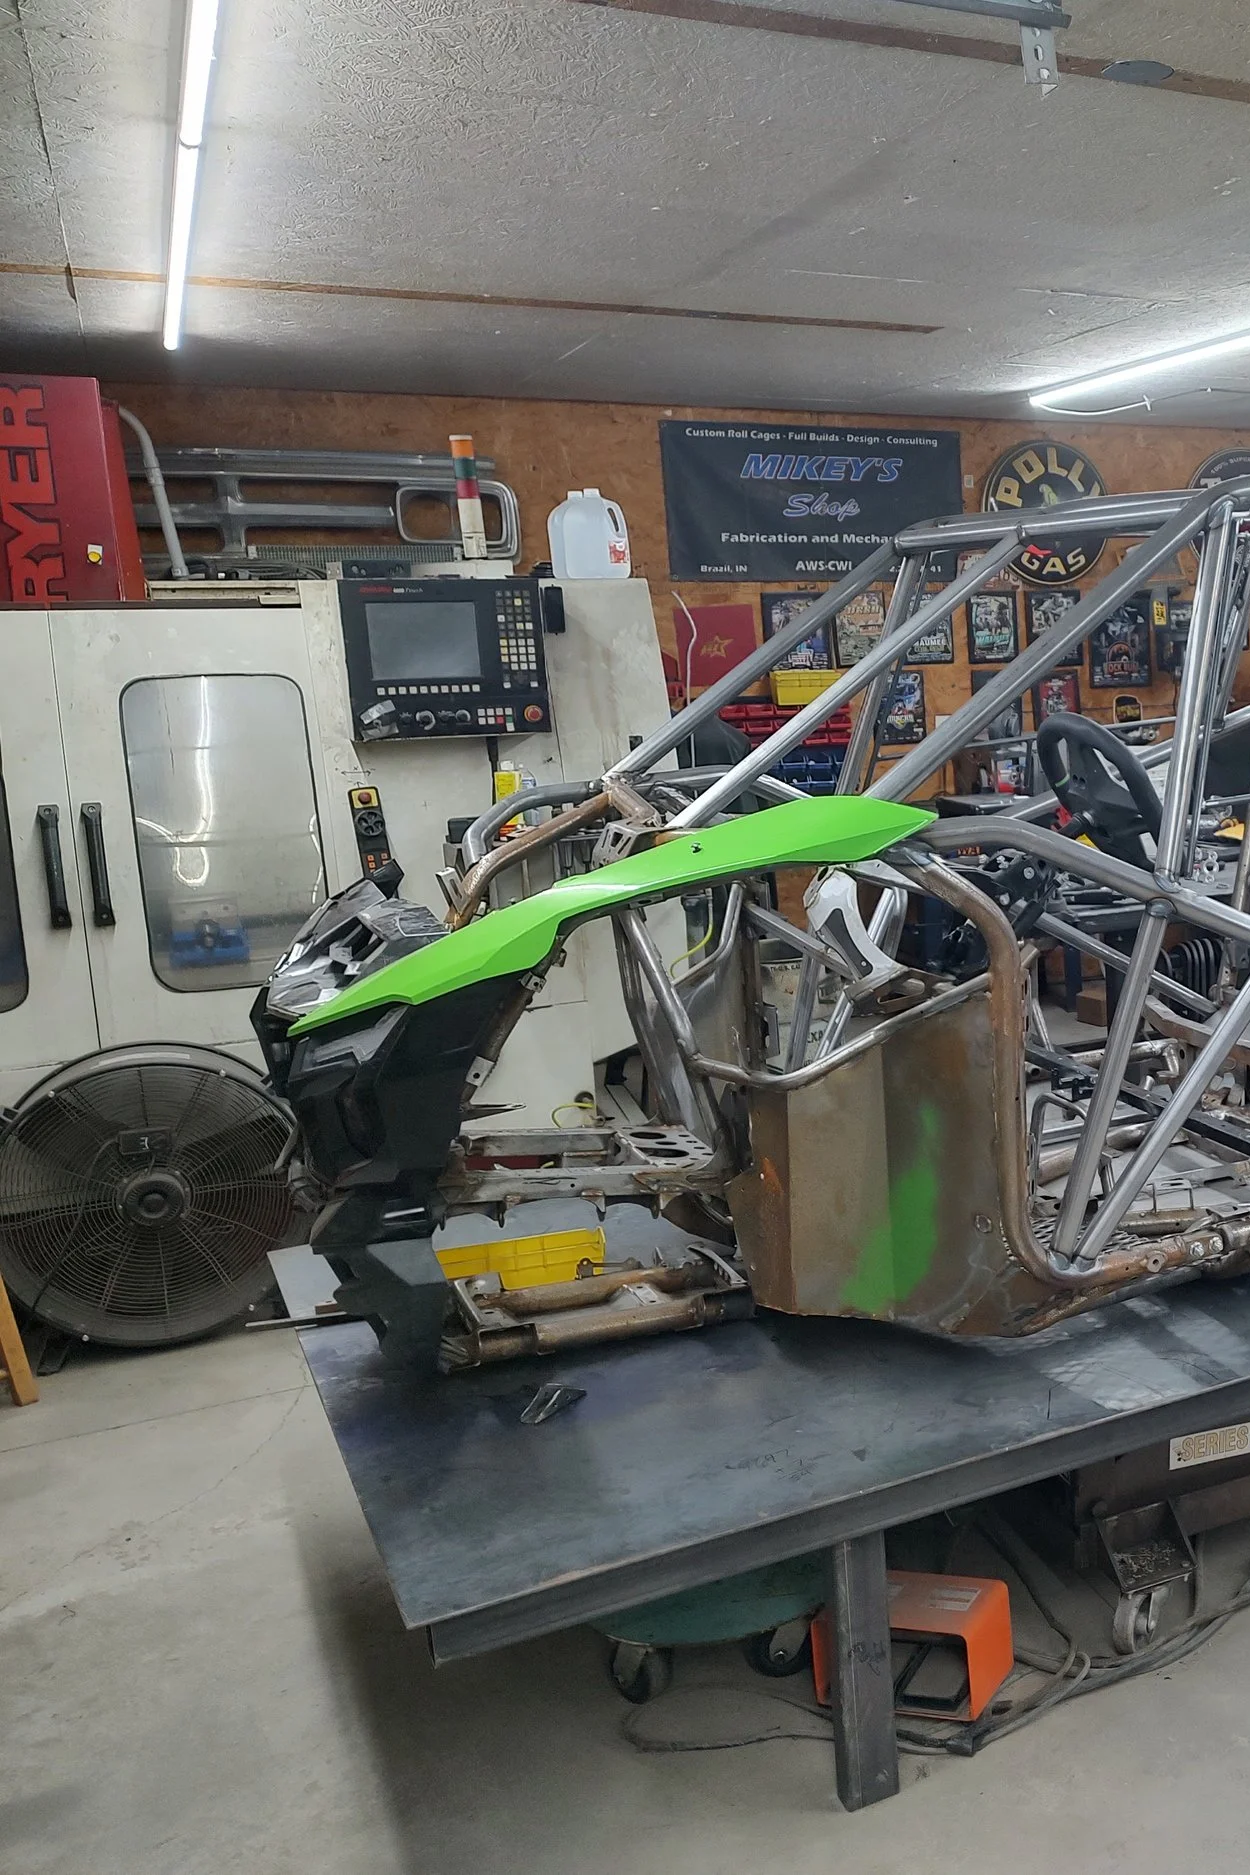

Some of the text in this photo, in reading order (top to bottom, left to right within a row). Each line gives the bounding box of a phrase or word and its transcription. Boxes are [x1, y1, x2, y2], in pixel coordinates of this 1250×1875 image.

[685, 427, 938, 448] Custom Roll Cages Full Builds Design Consulting
[740, 453, 903, 482] MIKEY'S
[783, 491, 861, 522] Shop
[721, 531, 894, 544] Fabrication and Mecha
[735, 564, 748, 572] IN
[1021, 547, 1086, 576] GAS
[1182, 1425, 1249, 1461] SERIES
